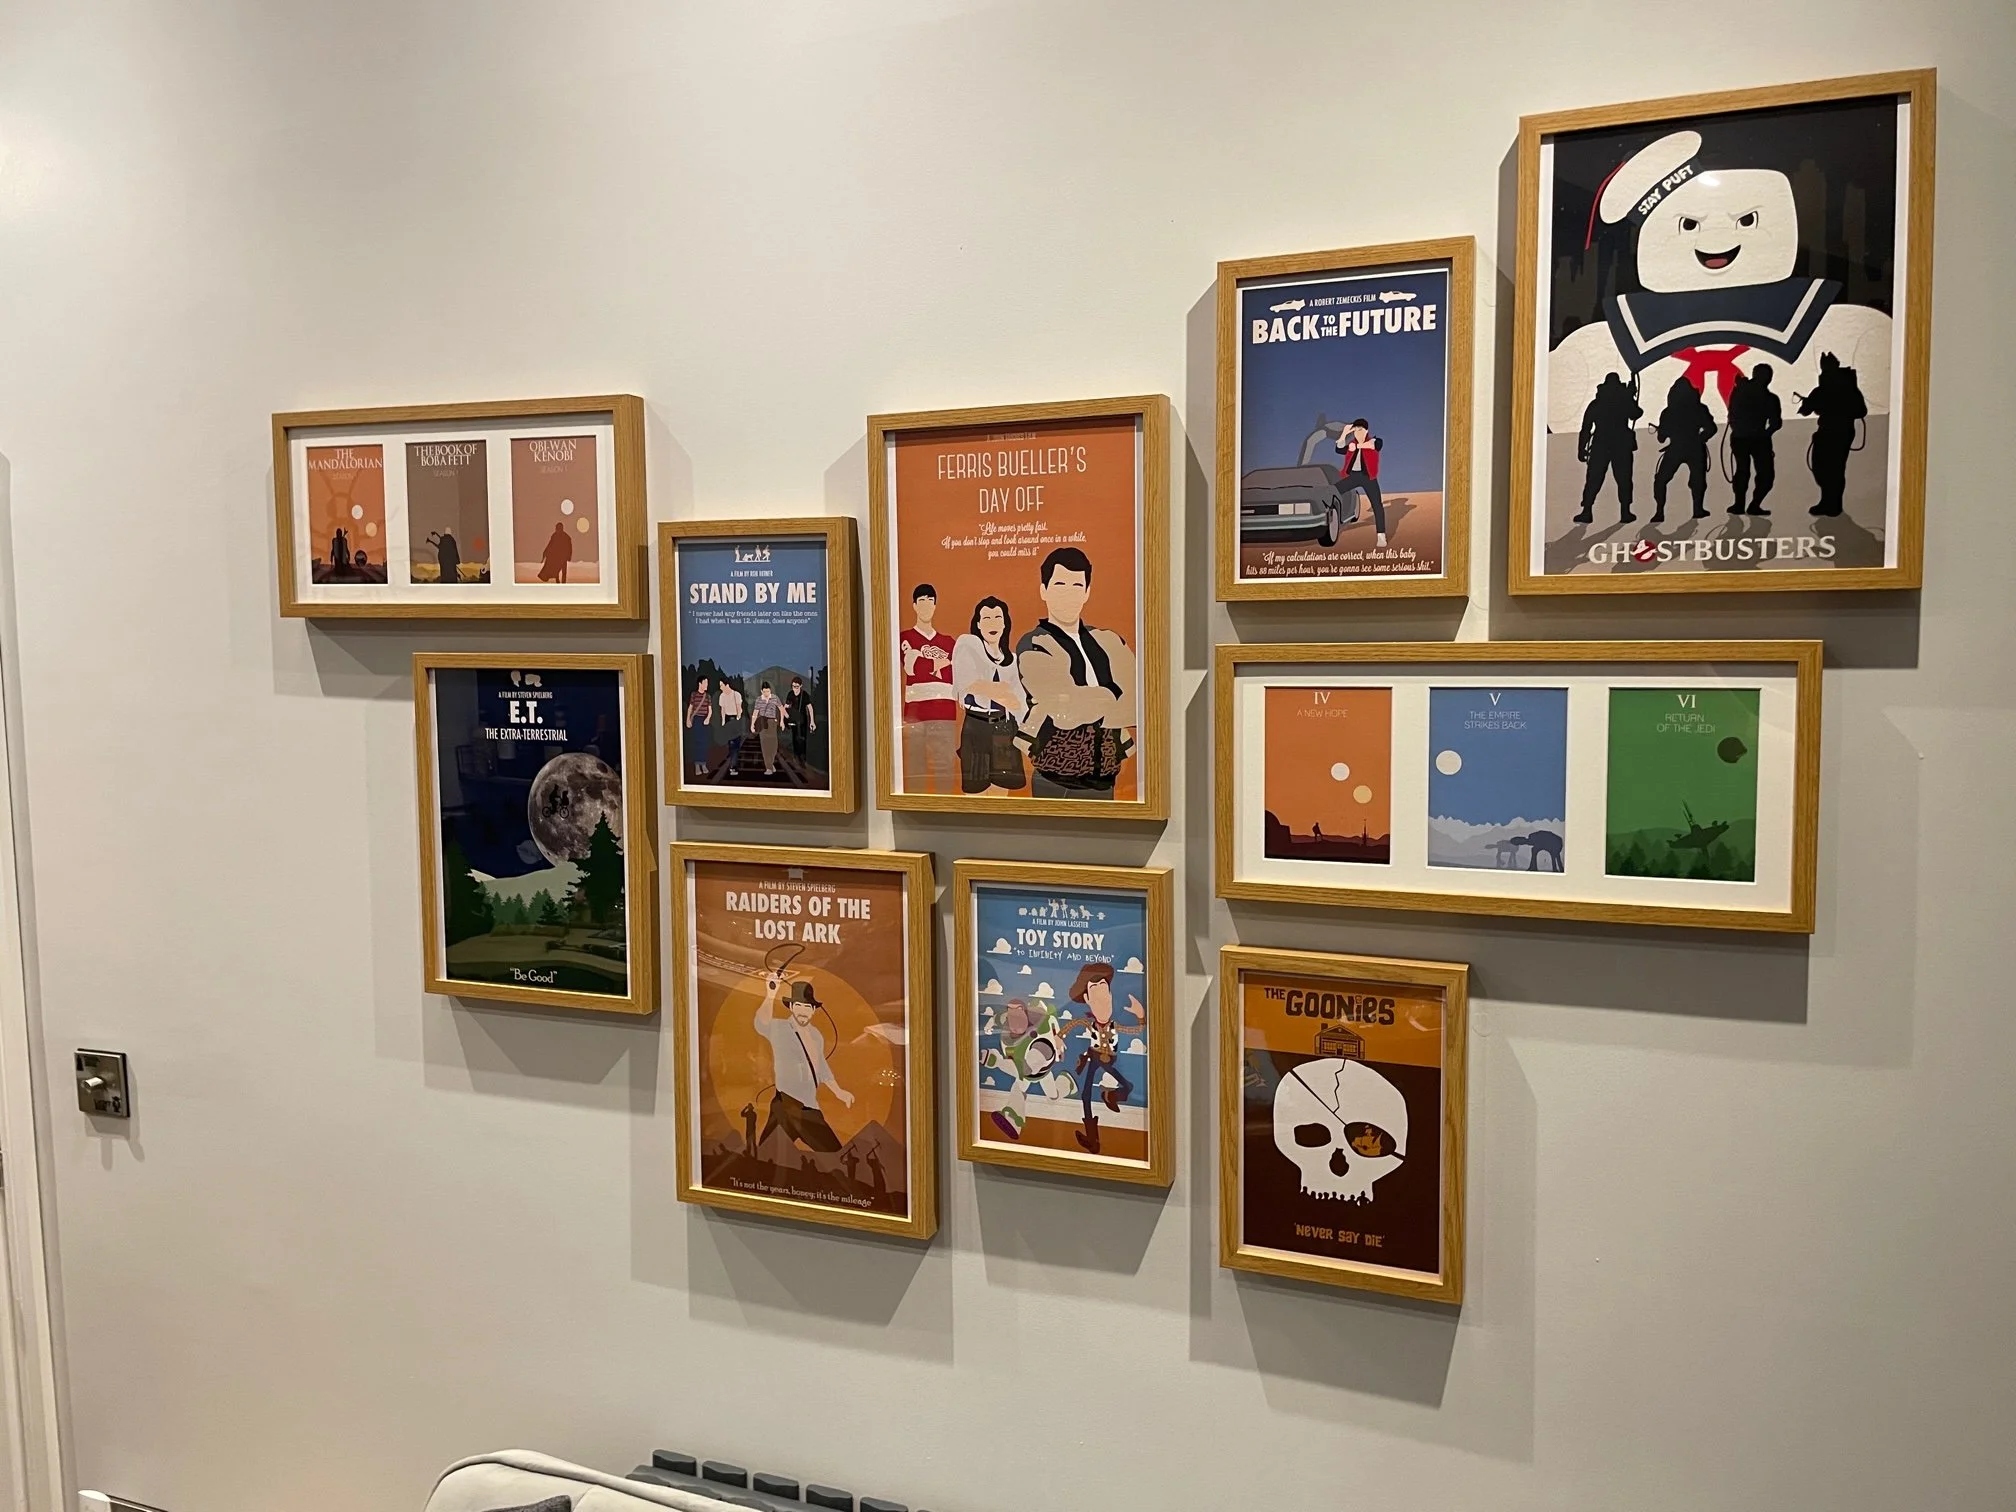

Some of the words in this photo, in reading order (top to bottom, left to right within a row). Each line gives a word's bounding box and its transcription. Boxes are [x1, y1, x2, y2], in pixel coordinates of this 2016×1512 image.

[1638, 188, 1662, 215] STAY
[1661, 165, 1694, 192] PUFT
[1309, 299, 1314, 307] A
[1314, 297, 1335, 307] ROBERT
[1335, 294, 1363, 305] ZEMECKIS
[1363, 293, 1377, 303] FILM
[1322, 314, 1336, 326] TO
[1338, 304, 1437, 337] FUTURE
[1252, 314, 1321, 344] BACK
[1320, 325, 1338, 337] THE
[414, 445, 434, 457] THE
[434, 443, 462, 456] BOOK
[462, 443, 478, 455] OF
[529, 439, 578, 452] OBI-WAN
[335, 448, 354, 461] THE
[421, 455, 447, 467] BOBA
[447, 454, 471, 466] FETT
[533, 449, 574, 463] KENOBI
[308, 457, 384, 471] MANDALORIAN
[937, 452, 993, 480] FERRIS
[998, 446, 1087, 477] BUELLER'S
[979, 487, 1010, 514] DAY
[1015, 485, 1045, 512] OFF
[997, 524, 1017, 533] moves
[1016, 522, 1035, 535] pretty
[941, 535, 951, 550] If
[950, 539, 962, 550] you
[962, 535, 977, 546] don't
[977, 536, 990, 549] stop
[990, 534, 1003, 546] and
[1003, 533, 1017, 545] look
[1017, 533, 1040, 545] around
[1039, 535, 1055, 544] once
[1054, 534, 1062, 543] in
[1062, 535, 1068, 543] a
[1067, 531, 1087, 543] while,
[987, 550, 999, 561] you
[999, 546, 1017, 557] could
[1017, 547, 1032, 557] miss
[1274, 554, 1287, 566] my
[1286, 550, 1327, 563] calculations
[1327, 552, 1340, 561] are
[1339, 550, 1366, 562] correct,
[1365, 548, 1385, 561] when
[1385, 547, 1400, 560] this
[1399, 547, 1417, 562] baby
[1245, 564, 1259, 576] hits
[1258, 566, 1268, 575] 88
[1267, 564, 1286, 575] miles
[1286, 566, 1298, 578] per
[1298, 563, 1316, 575] hour,
[1316, 563, 1338, 577] you're
[1338, 565, 1361, 577] gonna
[1360, 563, 1373, 573] see
[1372, 563, 1391, 573] some
[1391, 562, 1416, 573] serious
[689, 582, 748, 605] STAND
[754, 582, 781, 604] BY
[786, 581, 818, 604] ME
[724, 611, 736, 619] any
[498, 691, 502, 699] A
[502, 691, 512, 699] FILM
[511, 691, 518, 699] BY
[517, 691, 532, 699] STEVEN
[532, 691, 553, 699] SPIELBERG
[1313, 690, 1331, 705] IV
[1489, 692, 1502, 706] V
[1677, 694, 1696, 709] VI
[509, 700, 544, 724] E.T.
[1296, 709, 1303, 717] A
[1304, 709, 1323, 718] NEW
[1324, 709, 1349, 718] HOPE
[1469, 710, 1487, 720] THE
[1488, 710, 1521, 720] EMPIRE
[1664, 713, 1705, 723] RETURN
[1464, 720, 1500, 730] STRIKES
[1501, 721, 1527, 730] BACK
[1656, 724, 1670, 733] OF
[1673, 724, 1693, 734] THE
[1694, 724, 1716, 734] JEDI
[484, 727, 499, 740] THE
[500, 728, 568, 741] EXTRA-TERRESTRIAL
[758, 881, 764, 890] A
[764, 881, 777, 890] FILM
[777, 882, 785, 891] BY
[786, 882, 806, 892] STEVEN
[807, 883, 836, 894] SPIELBERG
[726, 891, 802, 915] RAIDERS
[808, 896, 832, 917] OF
[837, 897, 871, 920] THE
[1036, 918, 1047, 926] FILM
[1054, 919, 1067, 927] JOHN
[1067, 920, 1089, 928] LASSETER
[755, 919, 796, 941] LOST
[801, 922, 842, 945] ARK
[1016, 928, 1047, 947] TOY
[1052, 931, 1105, 951] STORY
[1066, 952, 1083, 961] AND
[509, 967, 527, 981] "Be
[528, 969, 558, 983] Good"
[1264, 987, 1286, 1000] THE
[743, 1182, 756, 1190] not
[756, 1181, 769, 1191] the
[769, 1186, 791, 1195] years,
[816, 1190, 828, 1200] it's
[827, 1191, 841, 1202] the
